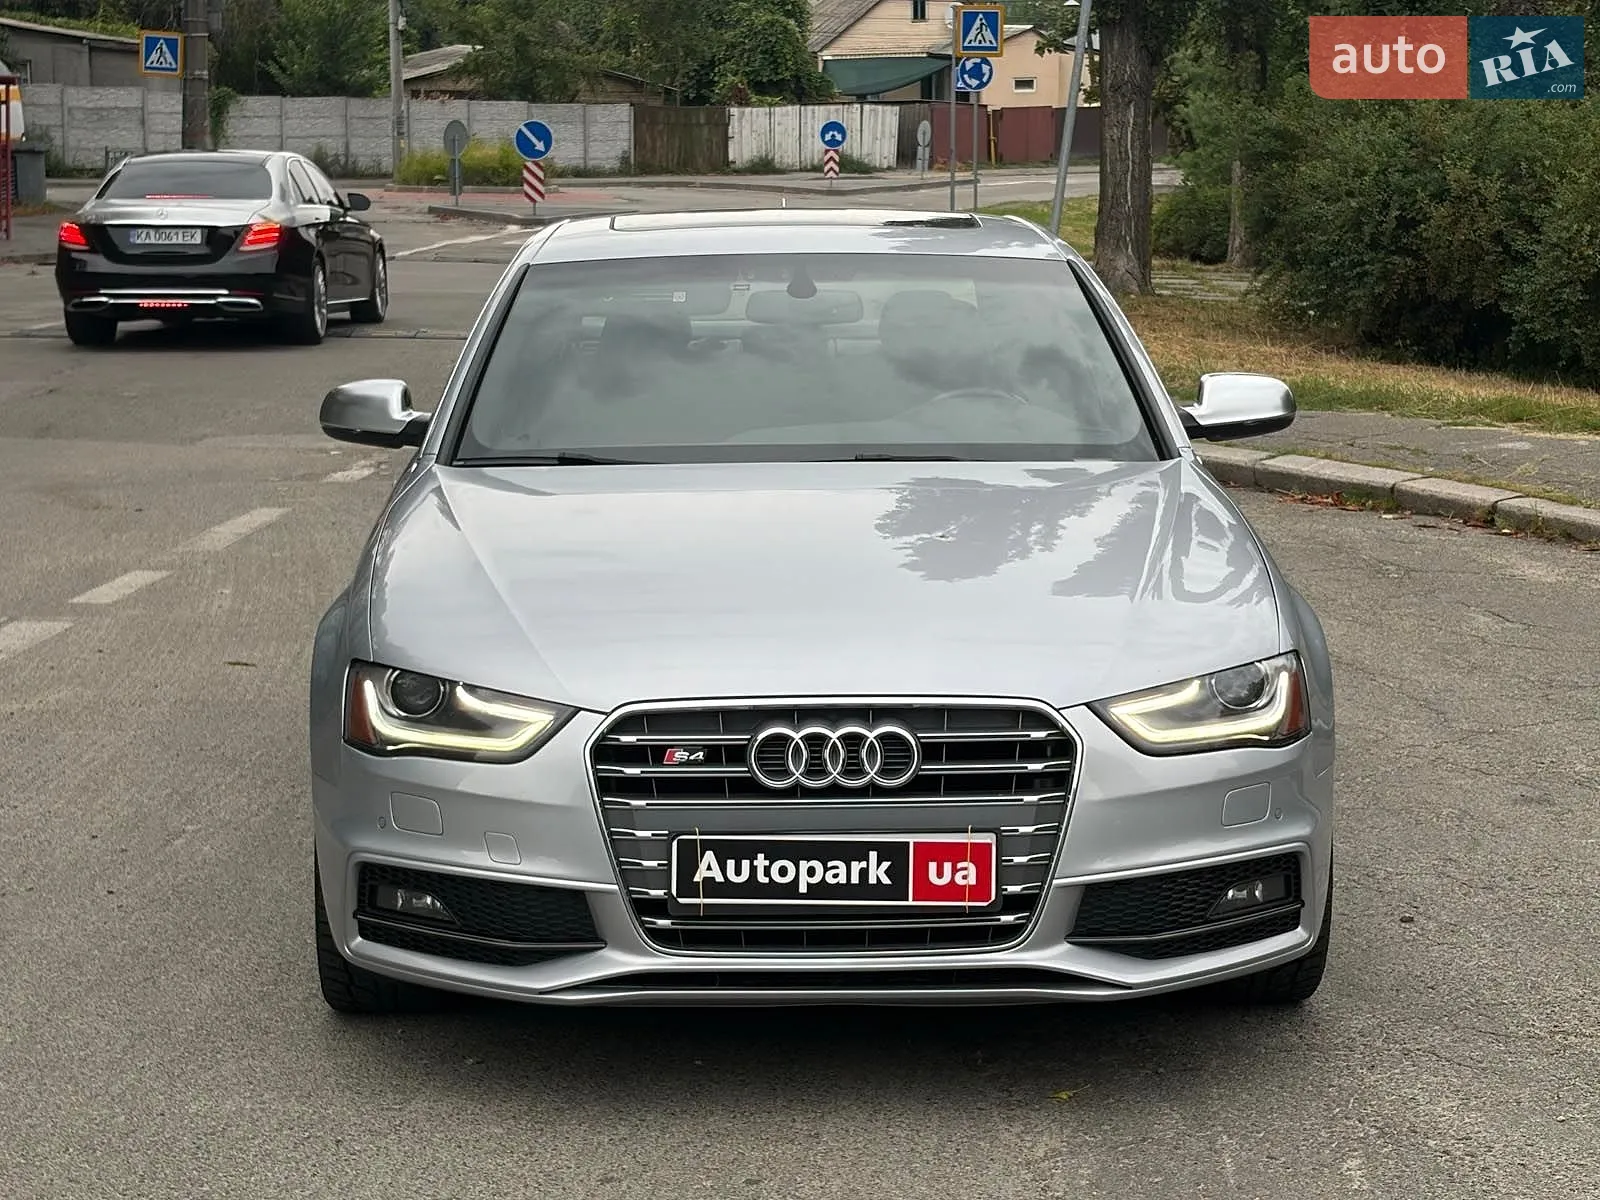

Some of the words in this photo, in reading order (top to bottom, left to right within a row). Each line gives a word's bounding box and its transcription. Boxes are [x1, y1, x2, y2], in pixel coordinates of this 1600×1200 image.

[136, 231, 152, 241] KA
[182, 231, 198, 242] EK
[693, 850, 893, 894] Autopark
[928, 860, 977, 886] ua
